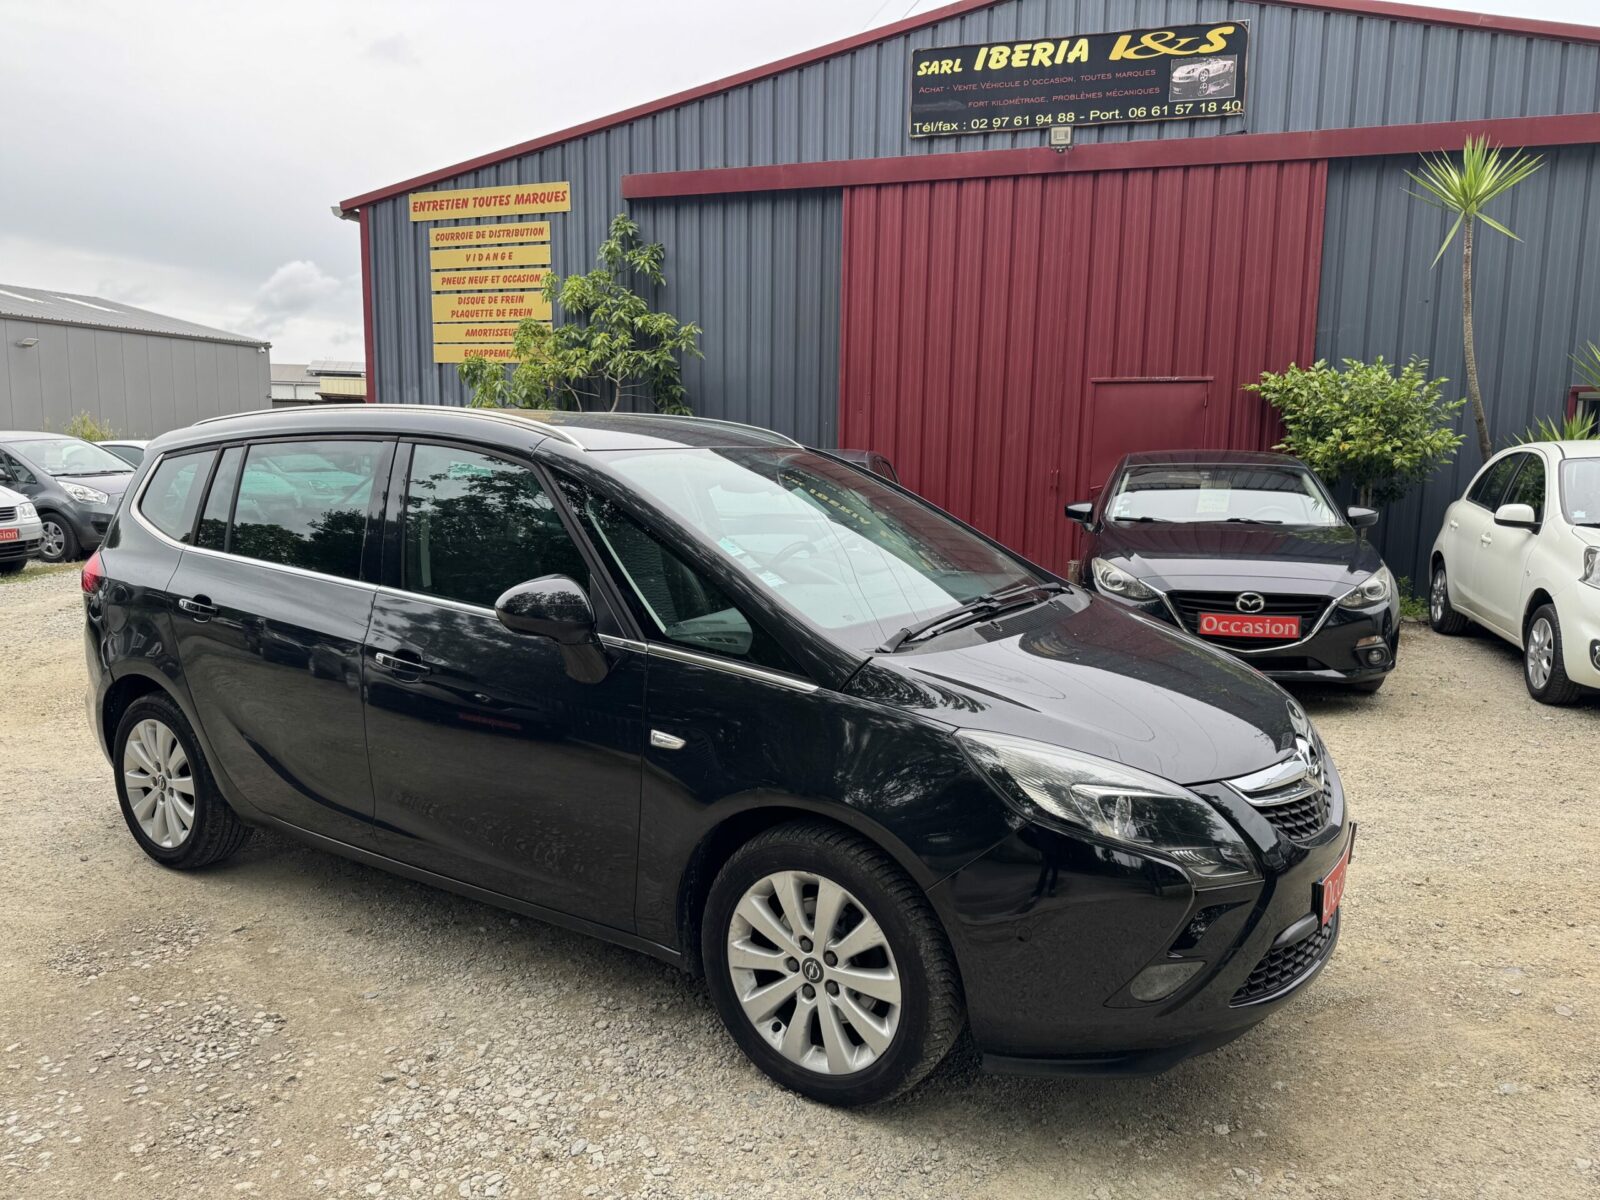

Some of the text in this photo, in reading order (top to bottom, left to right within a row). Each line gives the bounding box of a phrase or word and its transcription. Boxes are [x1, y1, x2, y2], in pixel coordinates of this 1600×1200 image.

[916, 58, 963, 76] SARL
[973, 38, 1089, 71] IBERIA
[1080, 73, 1112, 82] TOUTES
[1115, 69, 1156, 79] MARQUES
[968, 100, 989, 108] FORT
[1052, 90, 1103, 102] PROBLÈMES
[1106, 86, 1160, 97] MÉCANIQUES
[913, 121, 959, 133] Tél/fax
[971, 118, 988, 130] 02
[992, 117, 1009, 128] 97
[1014, 115, 1030, 126] 61
[1035, 114, 1053, 125] 94
[1057, 112, 1075, 123] 88
[1089, 109, 1123, 121] Port.
[1128, 107, 1147, 118] 06
[1151, 105, 1168, 117] 61
[1175, 103, 1193, 115] 57
[1199, 102, 1217, 113] 18
[1221, 100, 1241, 112] 40
[412, 190, 567, 213] ENTRETIEN TOUTES MARQUES
[435, 227, 545, 242] COURROIE DE DISTRIBUTION
[441, 273, 541, 286] PNEUS NEUF ET OCCASION
[457, 295, 525, 305] DISQUE DE FREIN
[450, 307, 533, 319] PLAQUETTE DE FREIN
[1201, 616, 1297, 636] Occasion
